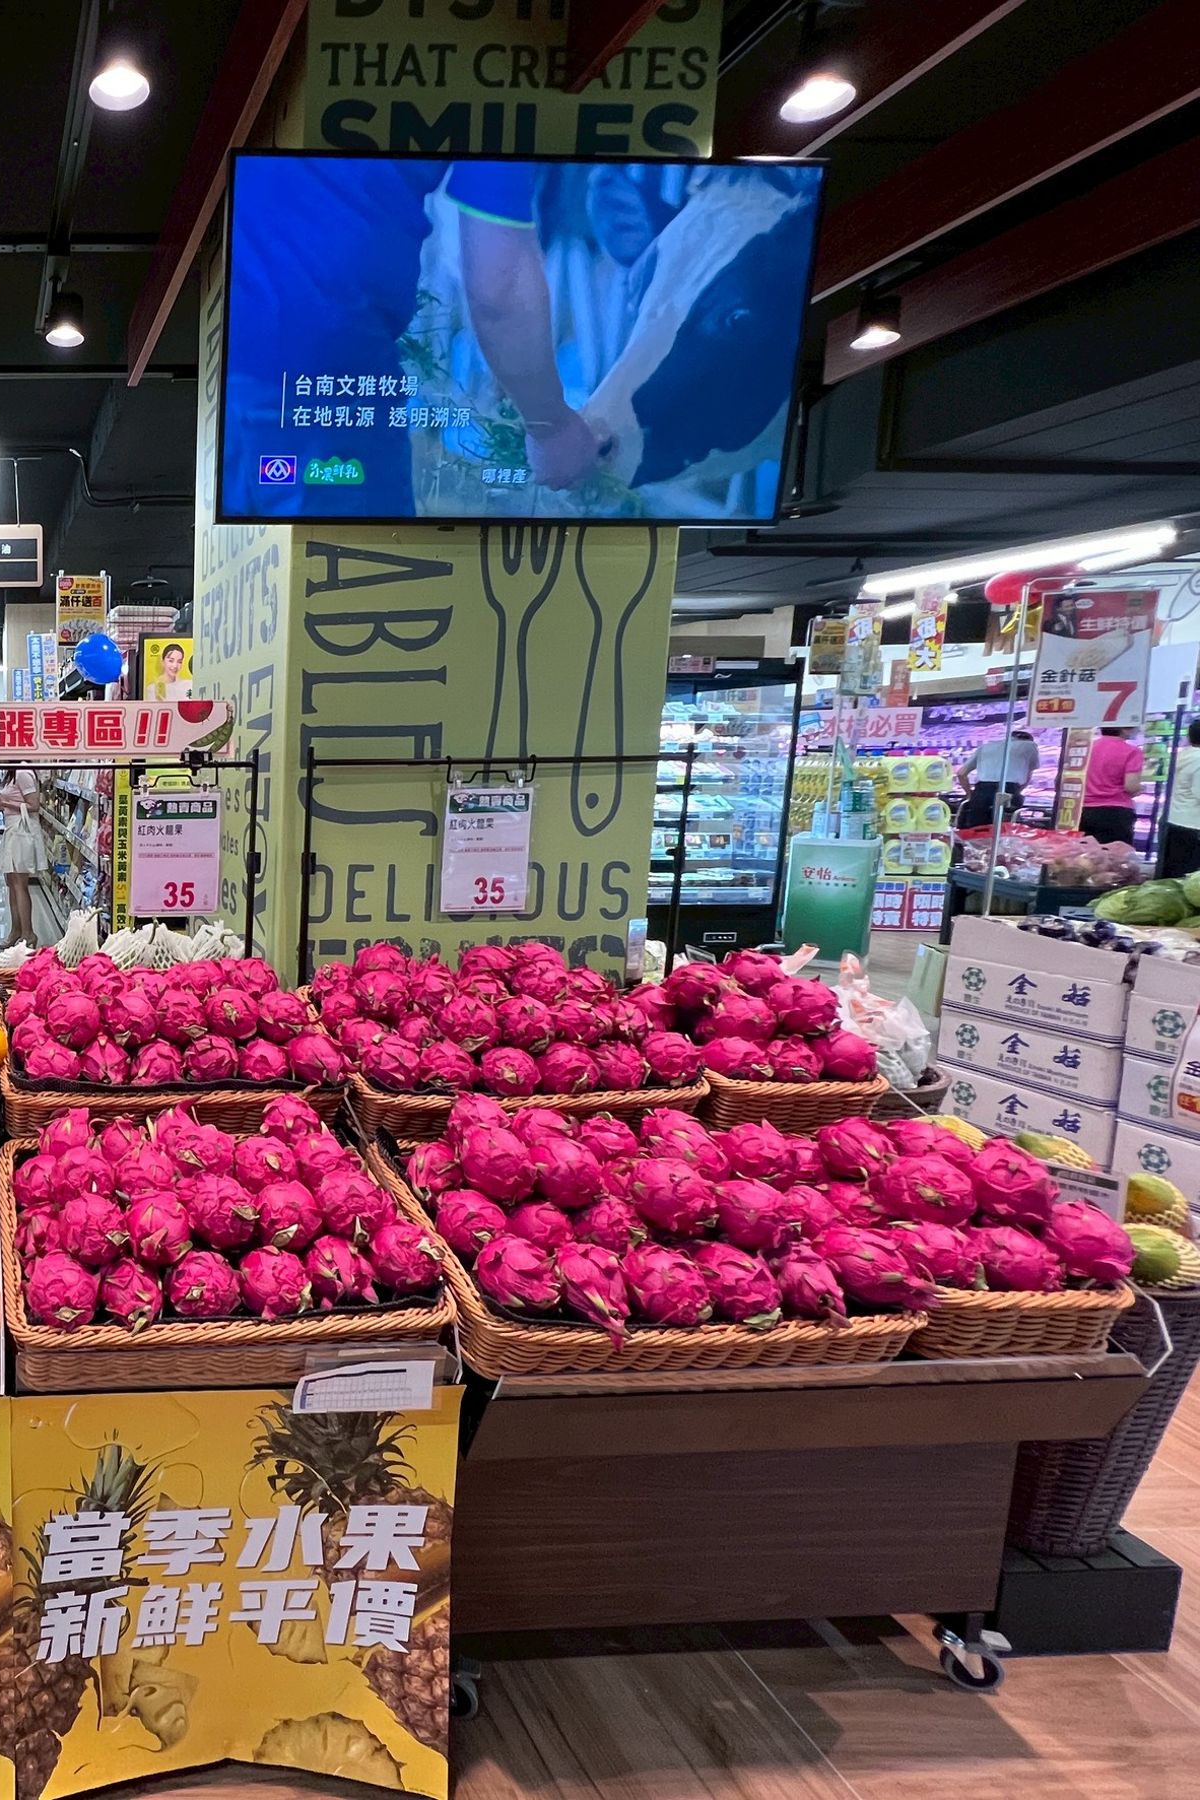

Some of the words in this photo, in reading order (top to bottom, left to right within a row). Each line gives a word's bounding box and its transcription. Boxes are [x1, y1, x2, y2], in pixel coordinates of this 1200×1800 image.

[321, 43, 457, 88] THAT
[473, 43, 709, 90] CRETES
[295, 374, 419, 397] 台南文雅牧場
[293, 406, 375, 428] 在地乳源
[388, 406, 471, 428] 透明溯源
[482, 468, 527, 484] 哪裡產
[201, 543, 280, 669] FRUITS
[1040, 668, 1097, 683] 金針菇
[1097, 681, 1138, 722] 7
[137, 824, 183, 836] 紅肉火龍果
[801, 866, 832, 881] 安怡
[163, 881, 196, 908] 35
[307, 860, 632, 925] DELIOUS
[473, 876, 506, 905] 35
[40, 1504, 430, 1584] 當季水果
[35, 1579, 419, 1664] 新鮮平價
